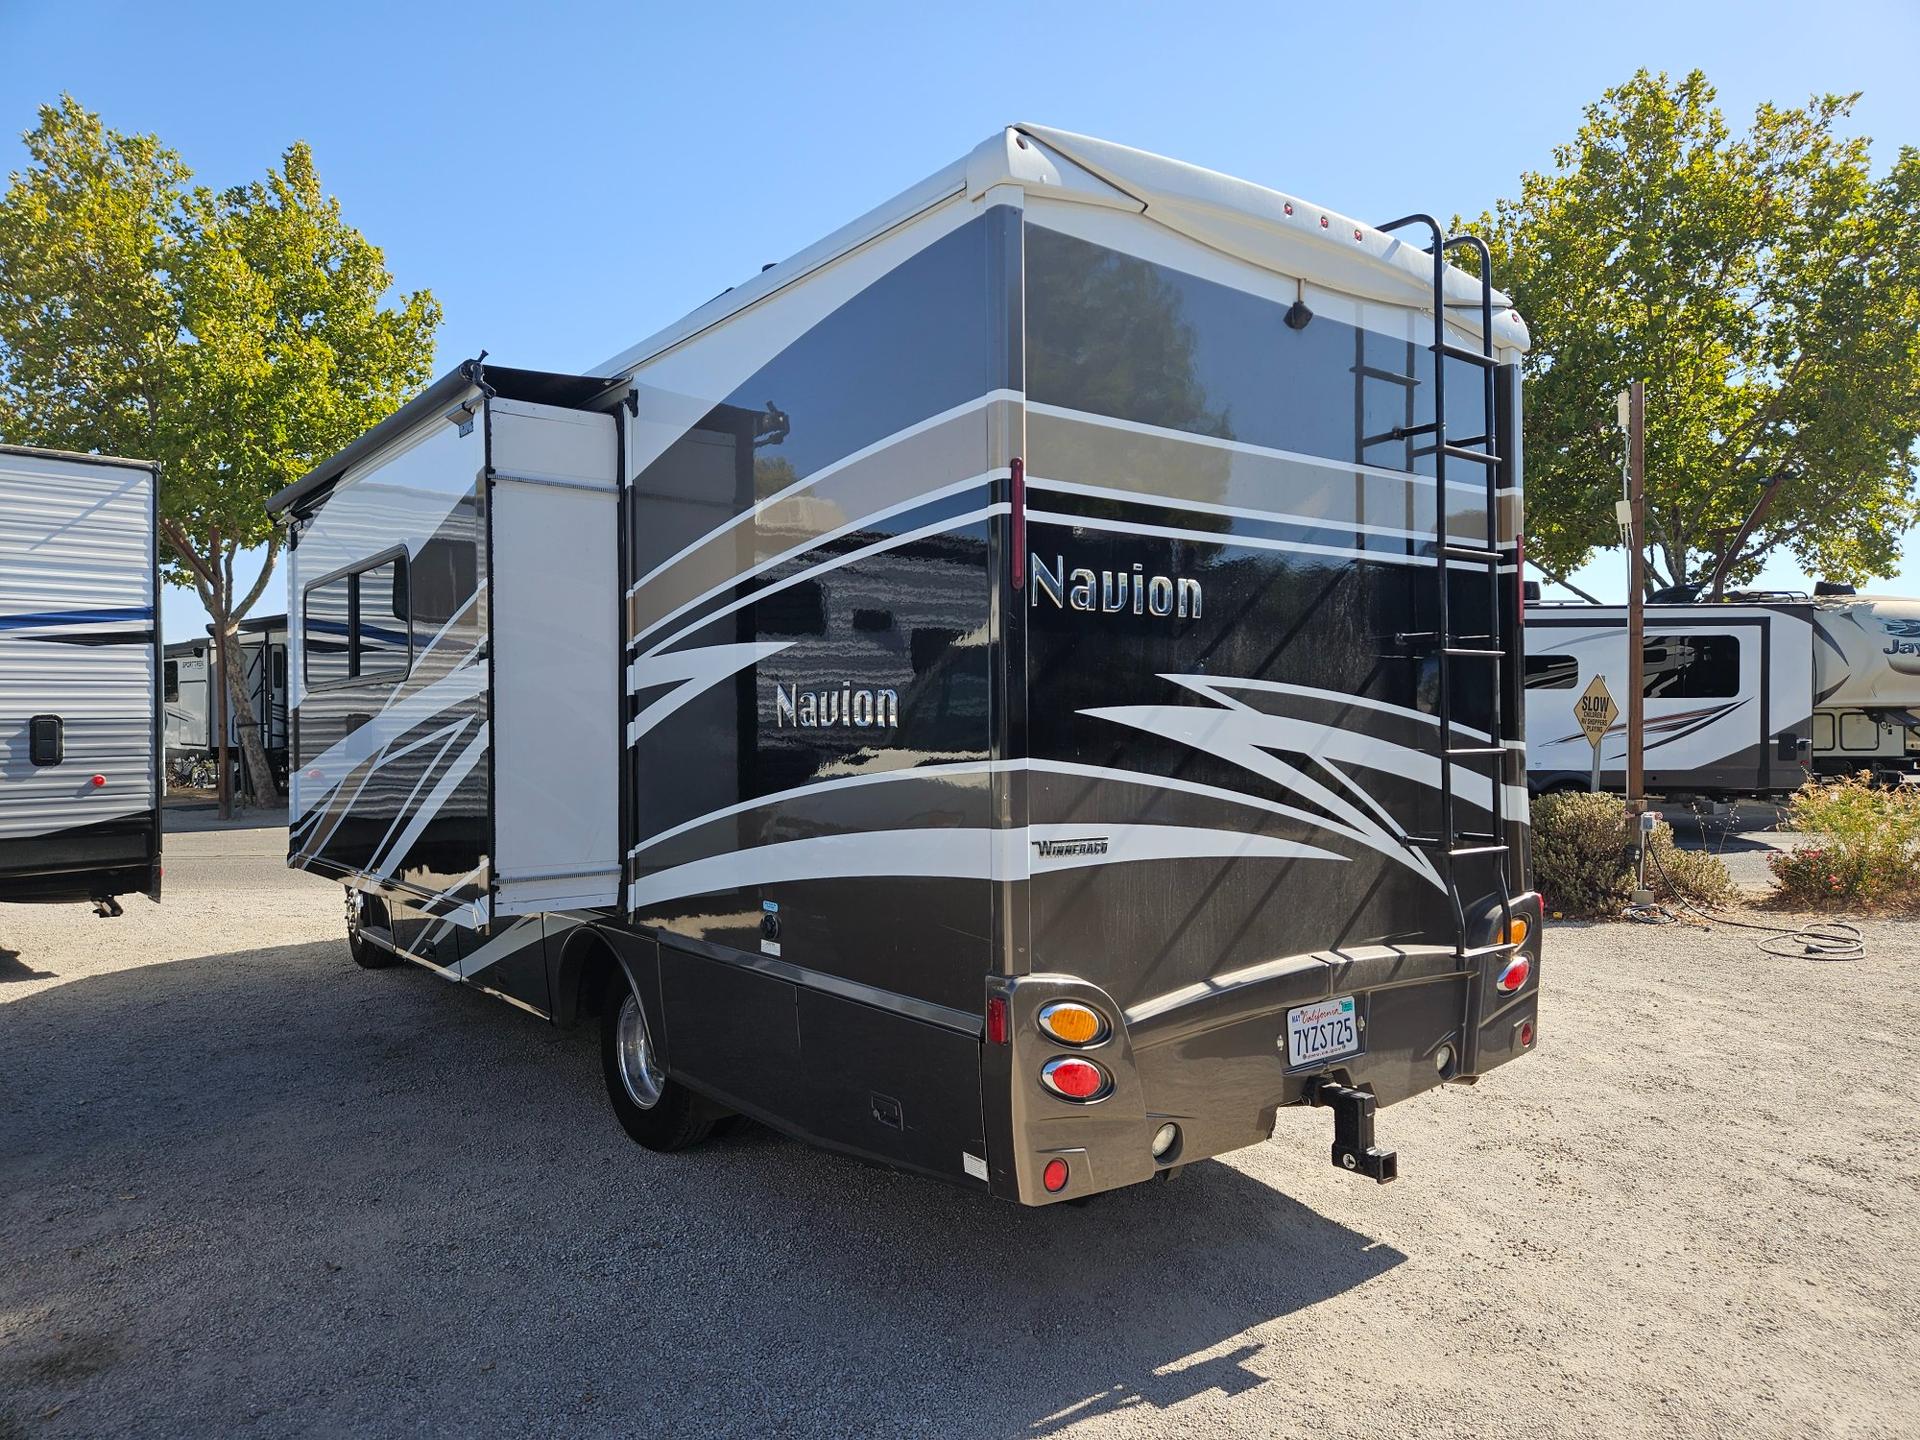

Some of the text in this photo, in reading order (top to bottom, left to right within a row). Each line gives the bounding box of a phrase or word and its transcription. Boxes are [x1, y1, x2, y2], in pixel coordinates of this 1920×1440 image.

[1581, 695, 1610, 712] SLOW
[1583, 711, 1602, 719] CHILDREN
[1586, 725, 1603, 733] PLAYING
[1587, 718, 1608, 727] SHOPPERS
[1291, 1008, 1340, 1025] MAY California
[1293, 1017, 1353, 1057] 7YZS725
